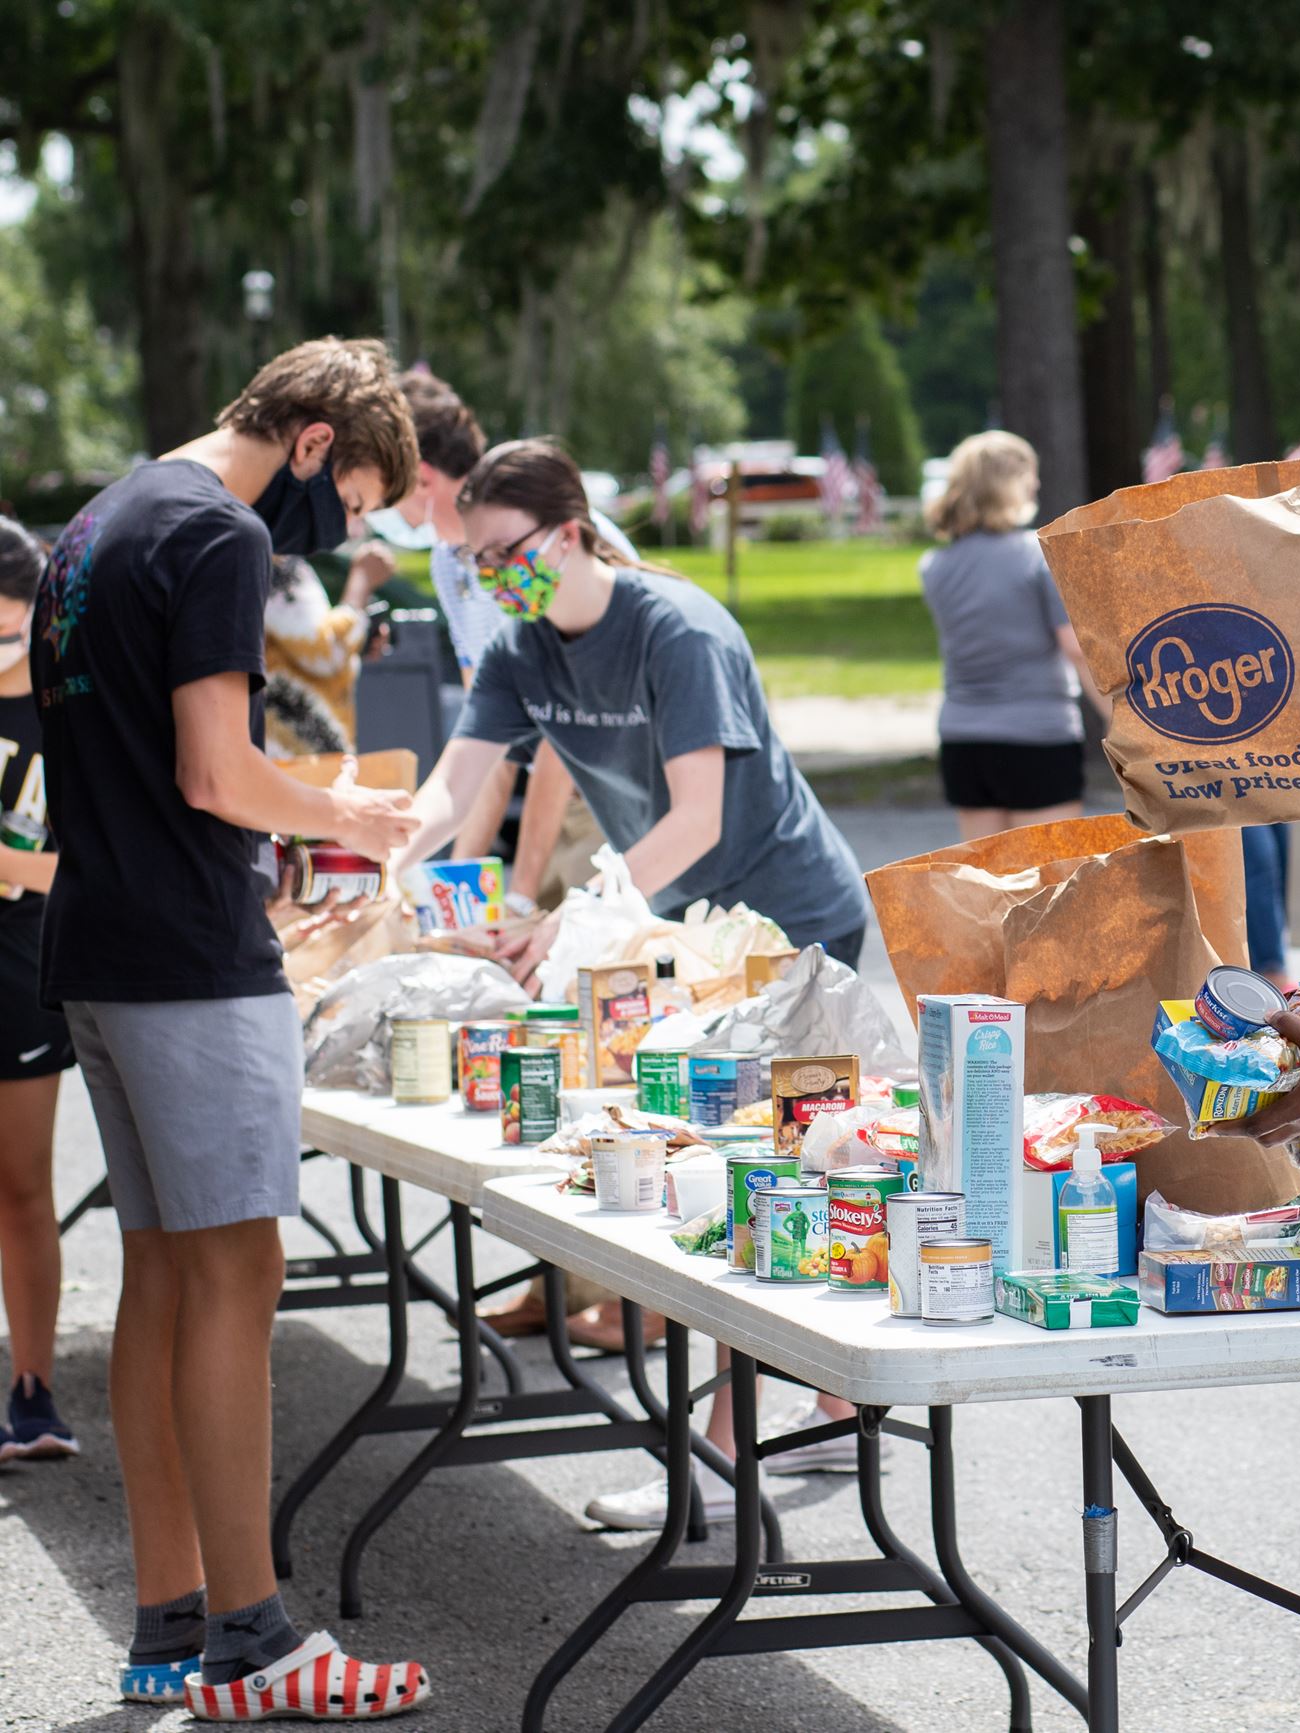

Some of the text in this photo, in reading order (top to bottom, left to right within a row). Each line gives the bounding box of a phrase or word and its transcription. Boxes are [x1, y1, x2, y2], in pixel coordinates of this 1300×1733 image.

[1137, 636, 1276, 727] Kroger
[1163, 777, 1223, 801] Low
[1203, 991, 1229, 1021] StarKist
[974, 1030, 1001, 1041] Crispy
[979, 1039, 997, 1051] Rice
[802, 1102, 846, 1112] MACARONI
[1213, 1085, 1228, 1119] RONZONI
[748, 1174, 772, 1182] Great
[829, 1203, 884, 1228] Stokely's
